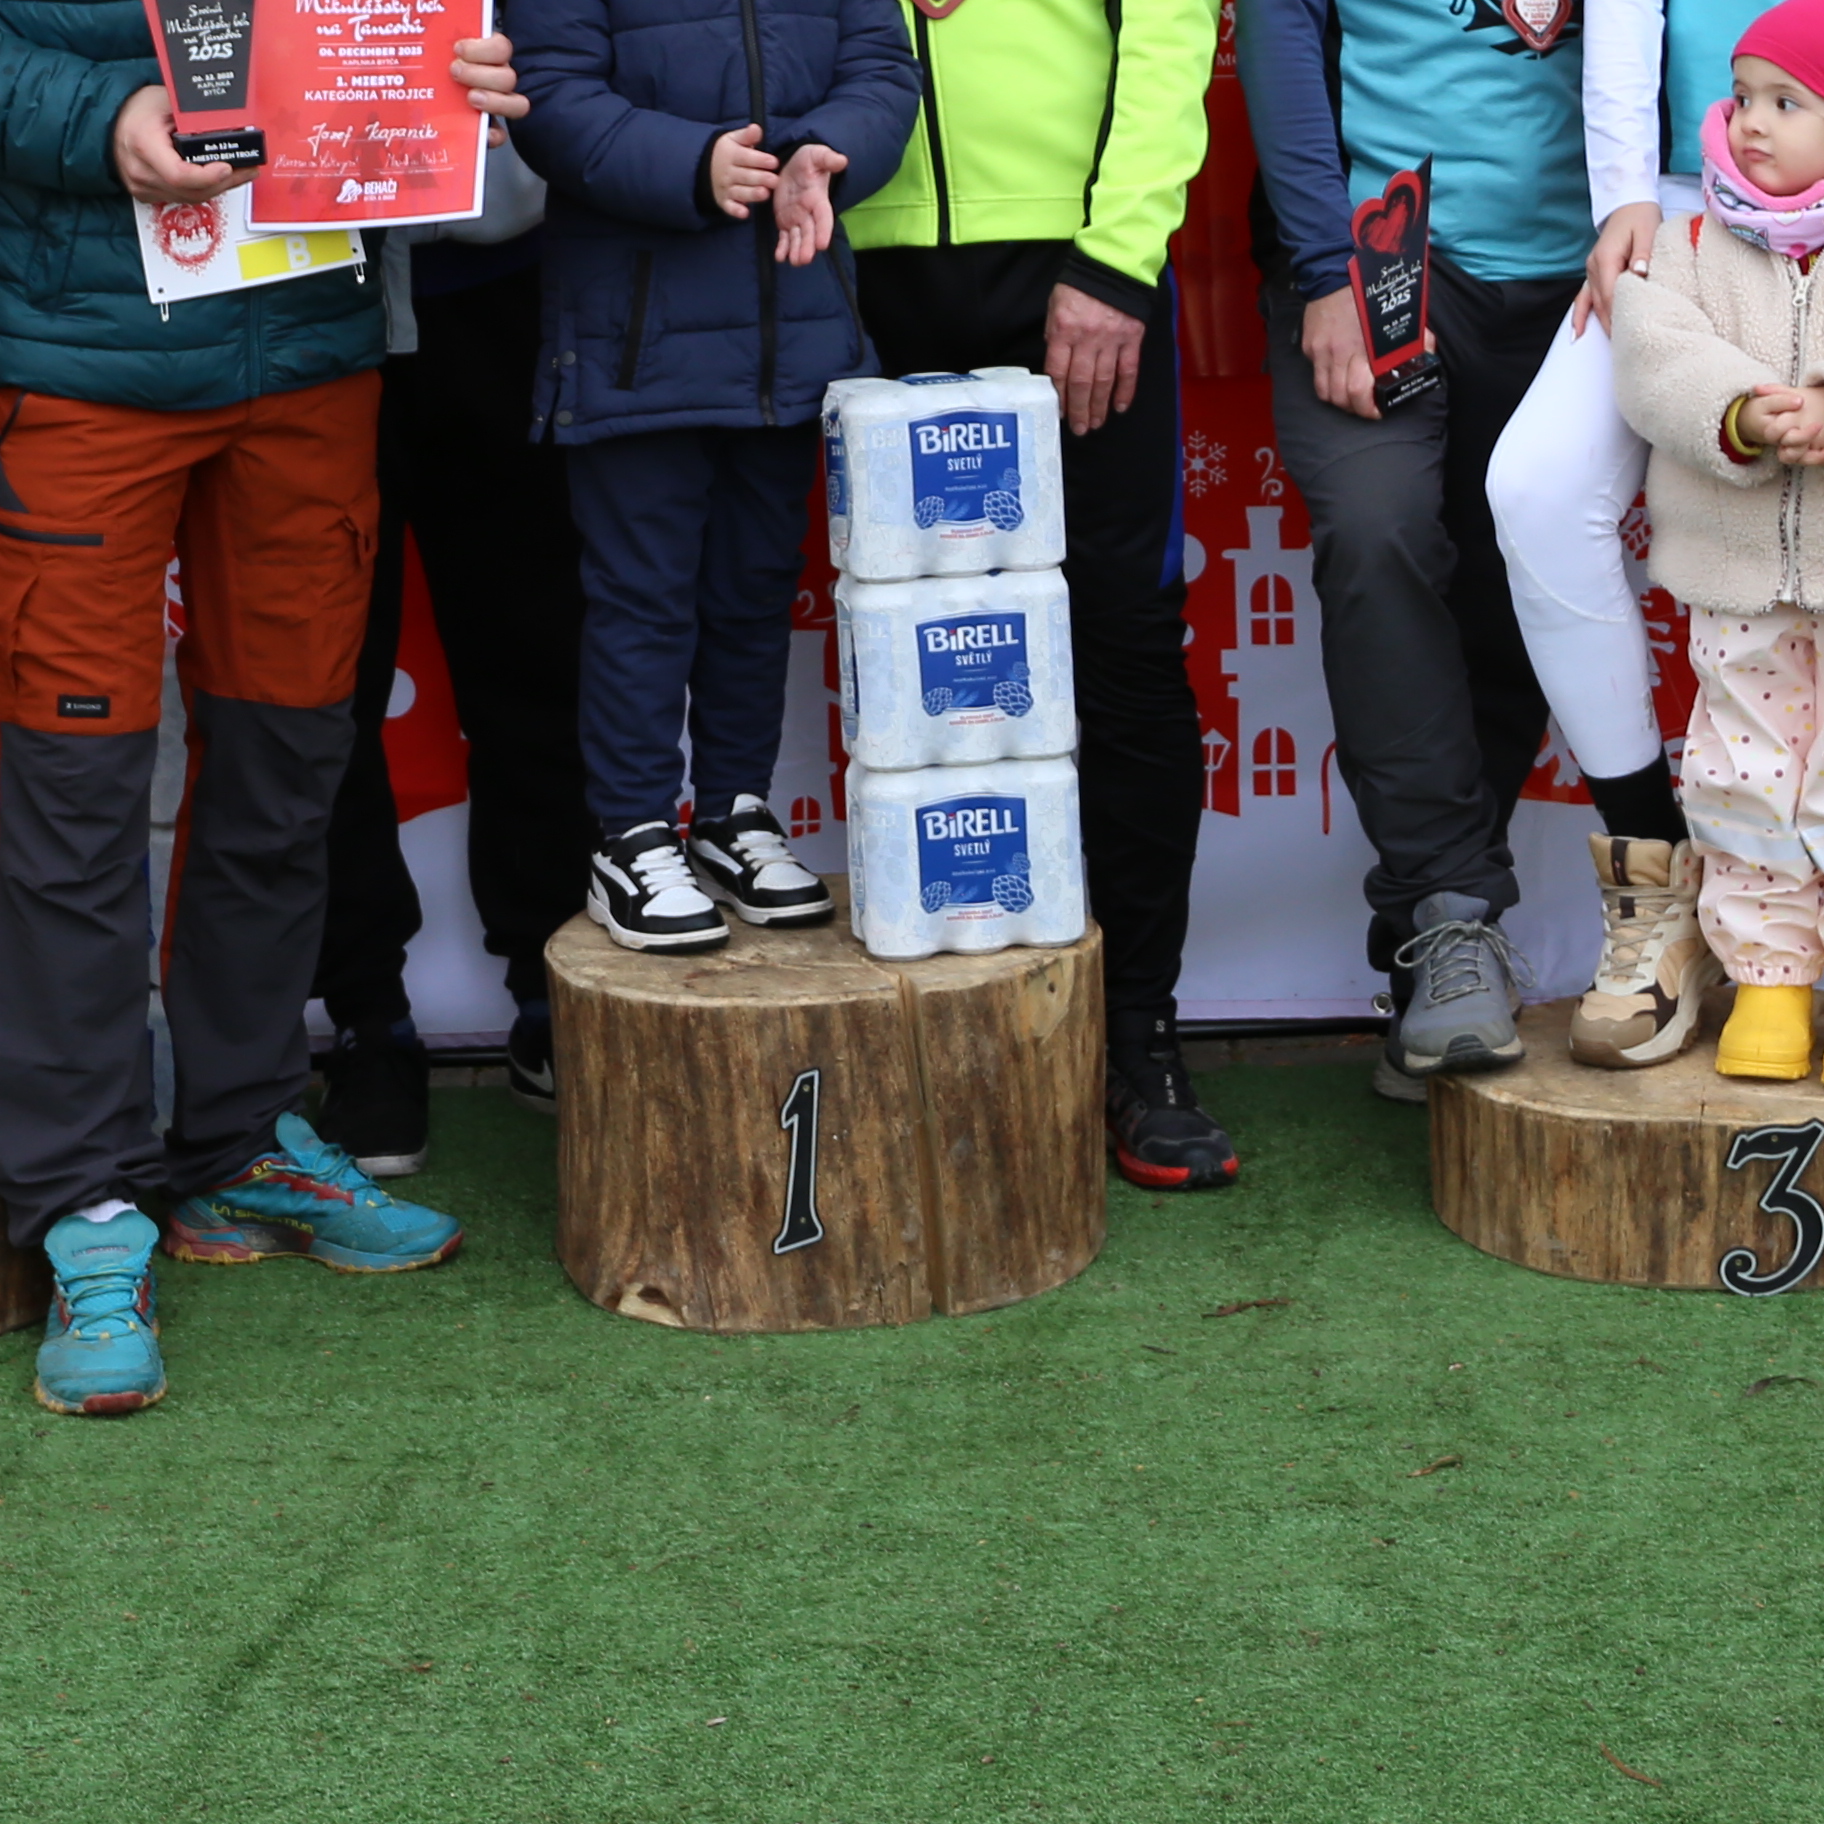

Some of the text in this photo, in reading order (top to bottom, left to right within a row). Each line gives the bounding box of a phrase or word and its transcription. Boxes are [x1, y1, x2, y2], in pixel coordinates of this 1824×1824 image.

[316, 23, 342, 35] na
[188, 42, 234, 61] 2025
[338, 46, 396, 57] DECEMBER
[351, 74, 405, 87] MIESTO
[304, 87, 435, 101] KATEGÓRIA TROJICE
[363, 178, 398, 196] BEHAČI
[285, 234, 312, 270] B
[947, 452, 983, 471] SVETLÝ
[954, 838, 991, 856] SVETLÝ
[774, 1069, 824, 1255] 1
